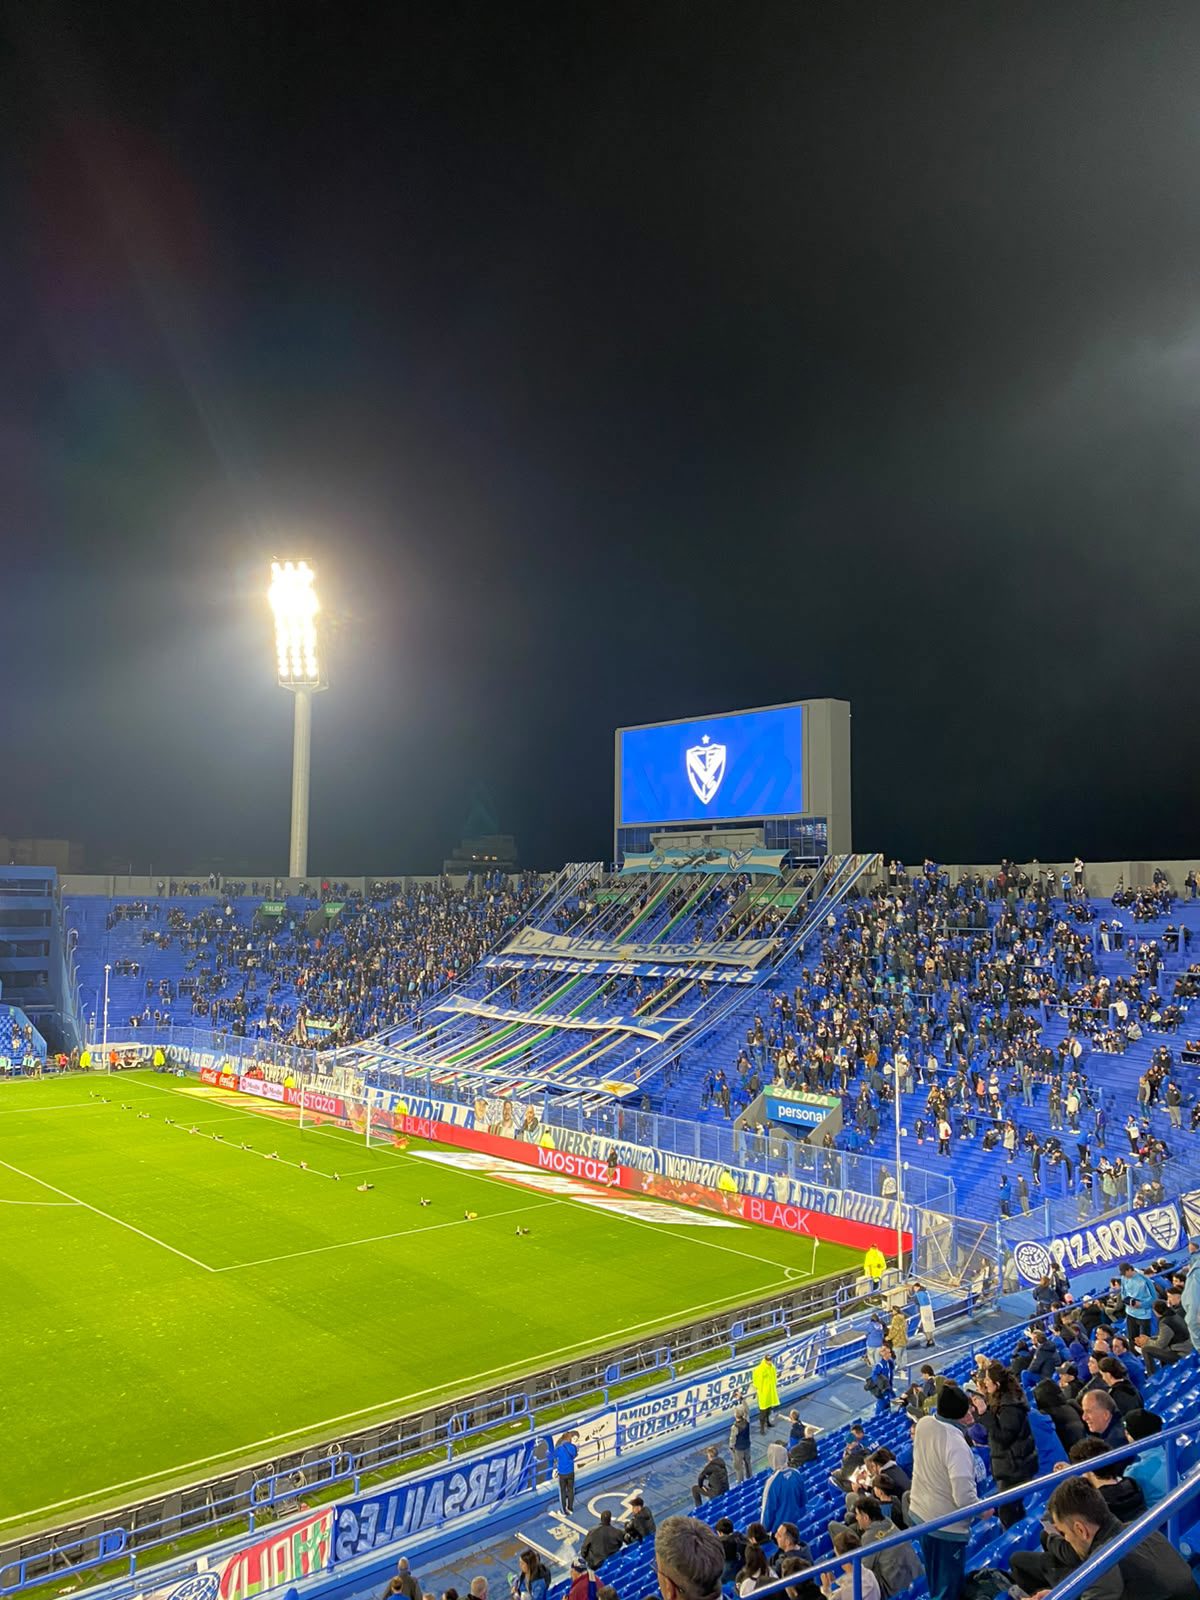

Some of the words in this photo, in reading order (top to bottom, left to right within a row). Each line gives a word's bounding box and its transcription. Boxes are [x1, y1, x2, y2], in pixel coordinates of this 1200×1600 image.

[606, 963, 641, 974] DE
[771, 1087, 829, 1106] SALIDA
[777, 1105, 827, 1123] personal
[405, 1116, 438, 1139] BLACK
[750, 1199, 811, 1233] BLACK
